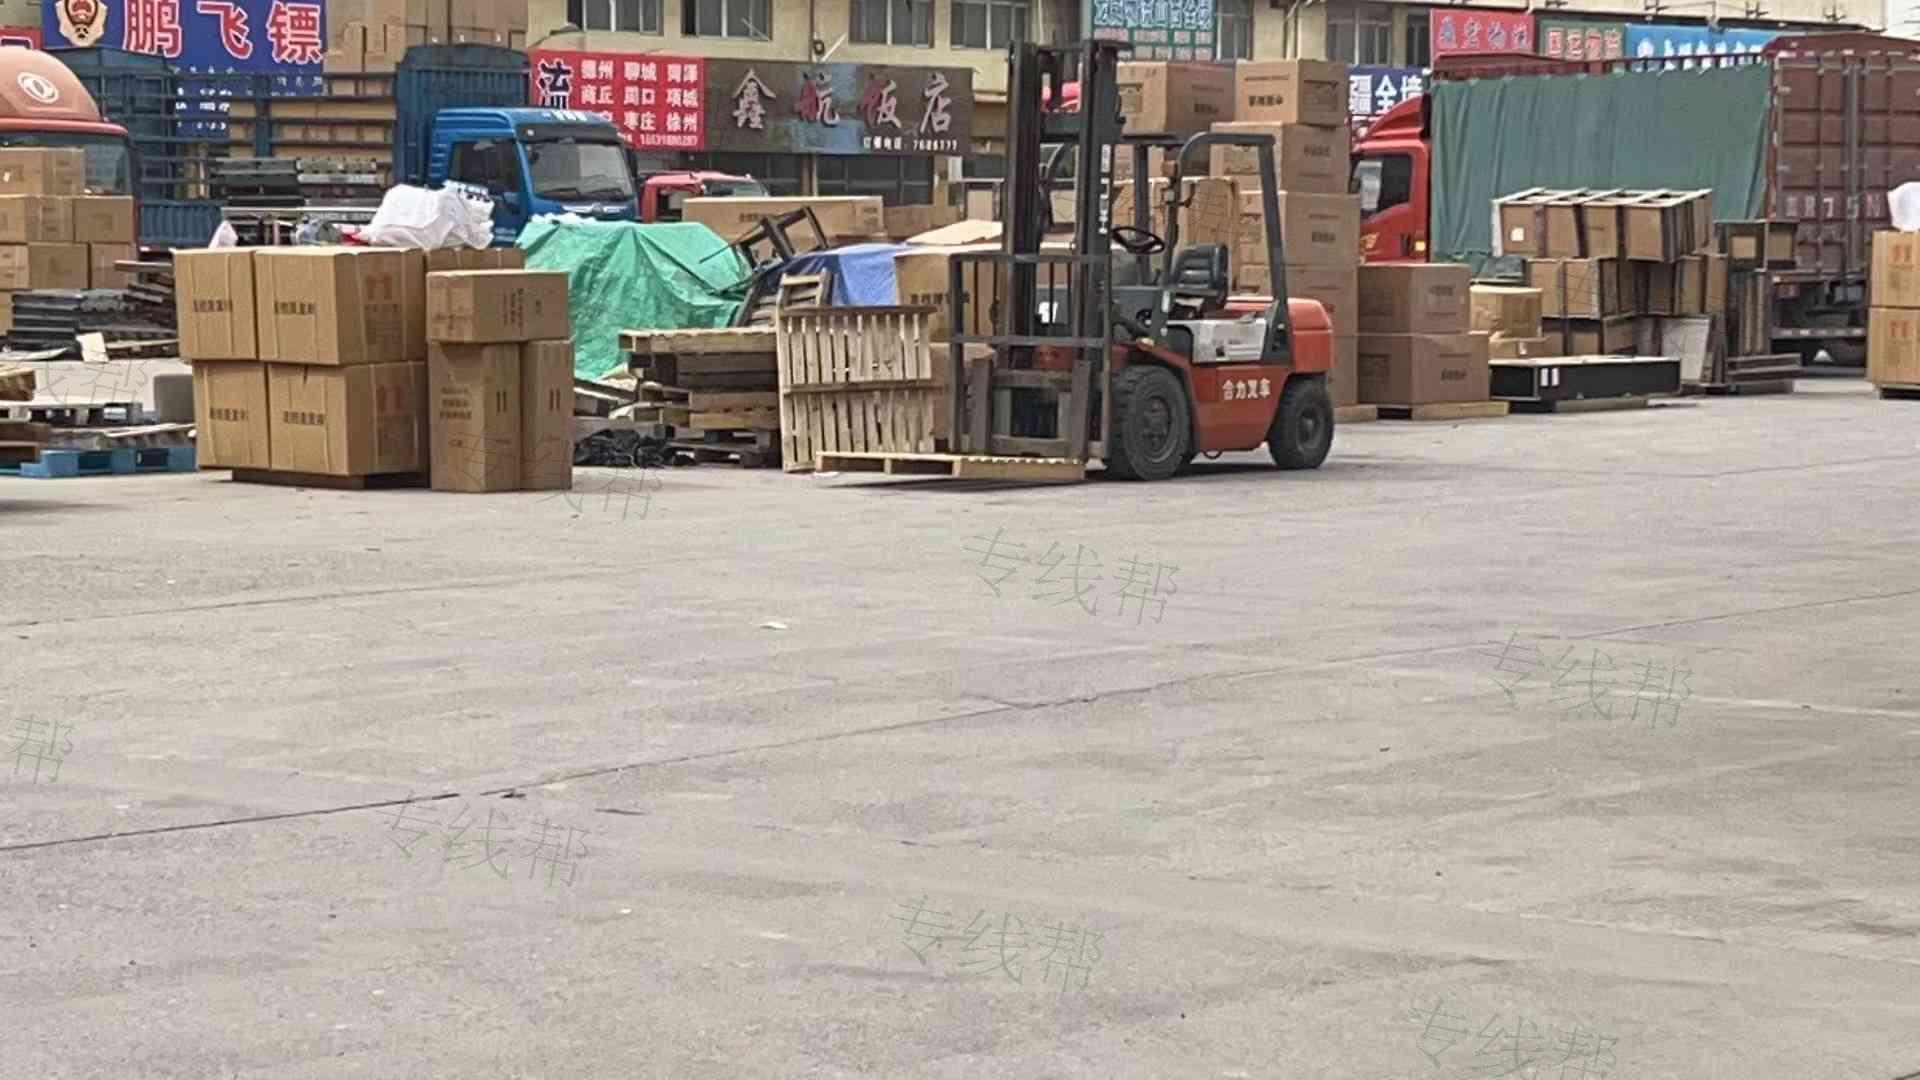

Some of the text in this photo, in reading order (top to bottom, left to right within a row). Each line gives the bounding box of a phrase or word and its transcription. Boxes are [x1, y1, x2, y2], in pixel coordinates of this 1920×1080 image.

[122, 0, 323, 64] 鹏飞镖
[580, 84, 614, 105] 商丘
[623, 86, 656, 106] 周口
[732, 68, 952, 135] 鑫航饭店
[623, 111, 656, 132] 枣庄
[666, 112, 698, 133] 徐州
